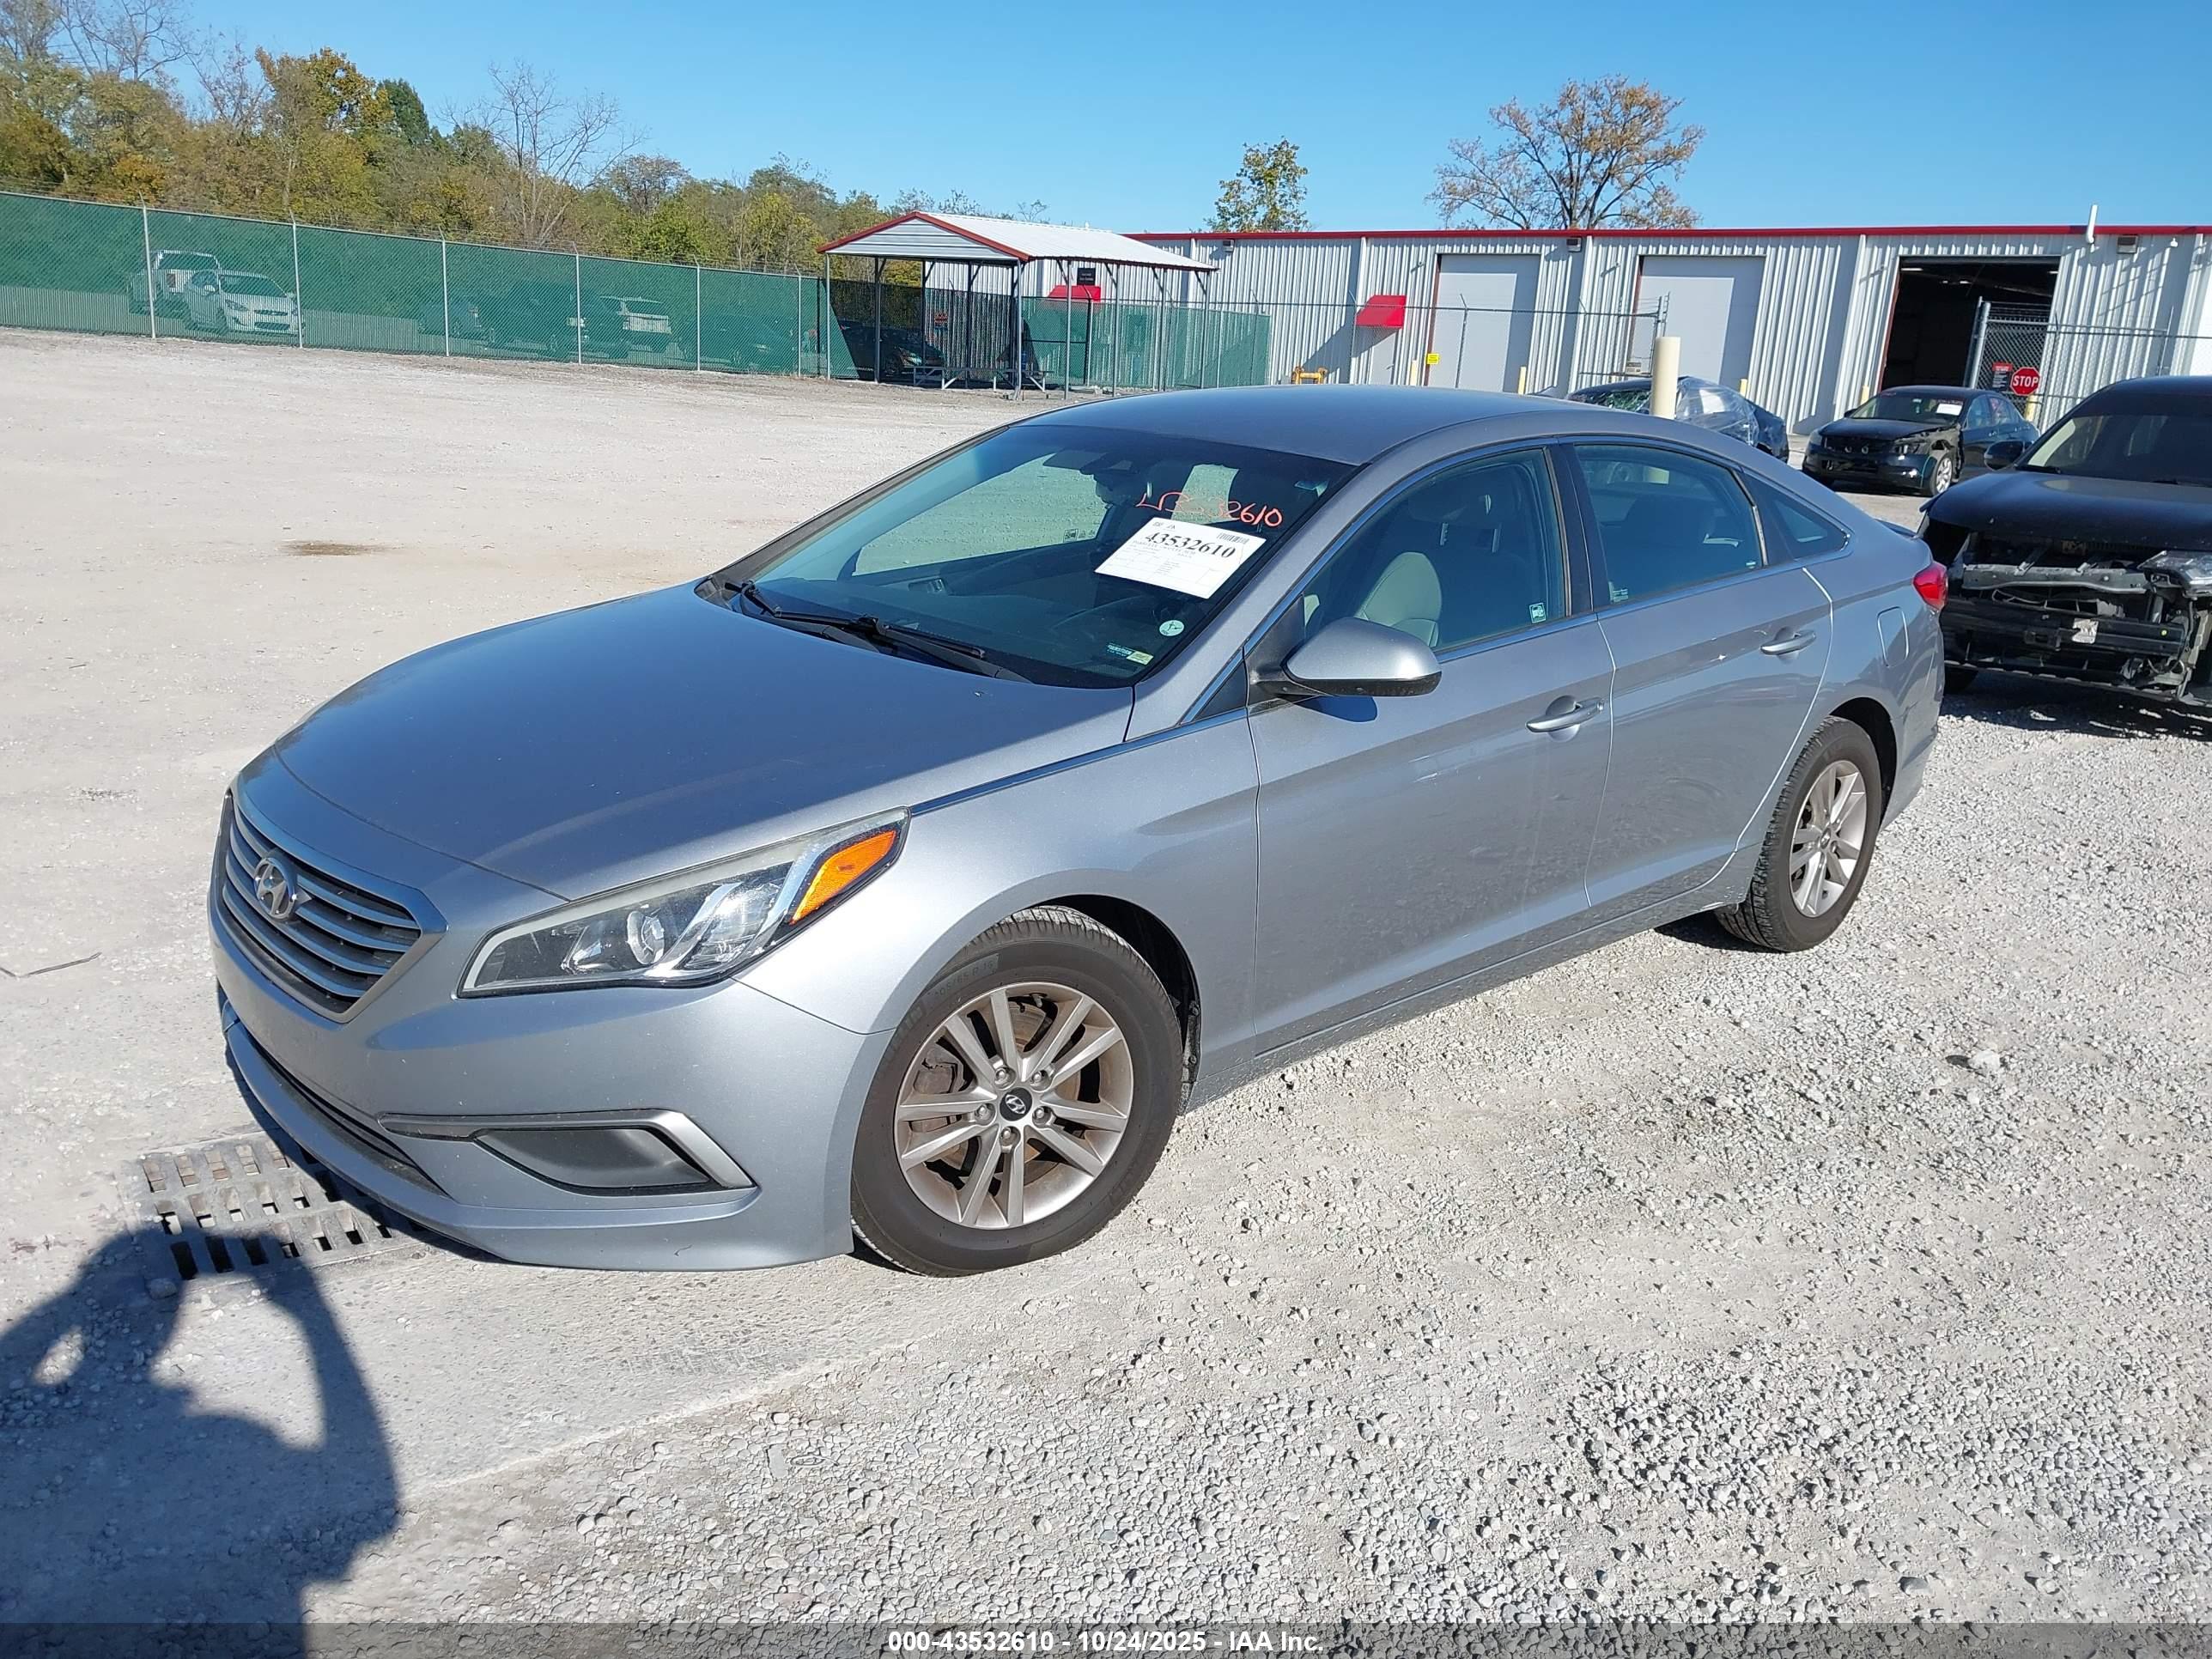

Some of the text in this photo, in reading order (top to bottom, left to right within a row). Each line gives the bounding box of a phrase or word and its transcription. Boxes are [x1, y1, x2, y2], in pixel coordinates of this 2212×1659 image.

[2012, 374, 2039, 388] STOP
[1135, 491, 1283, 527] 4332610
[1145, 532, 1237, 558] 43532610
